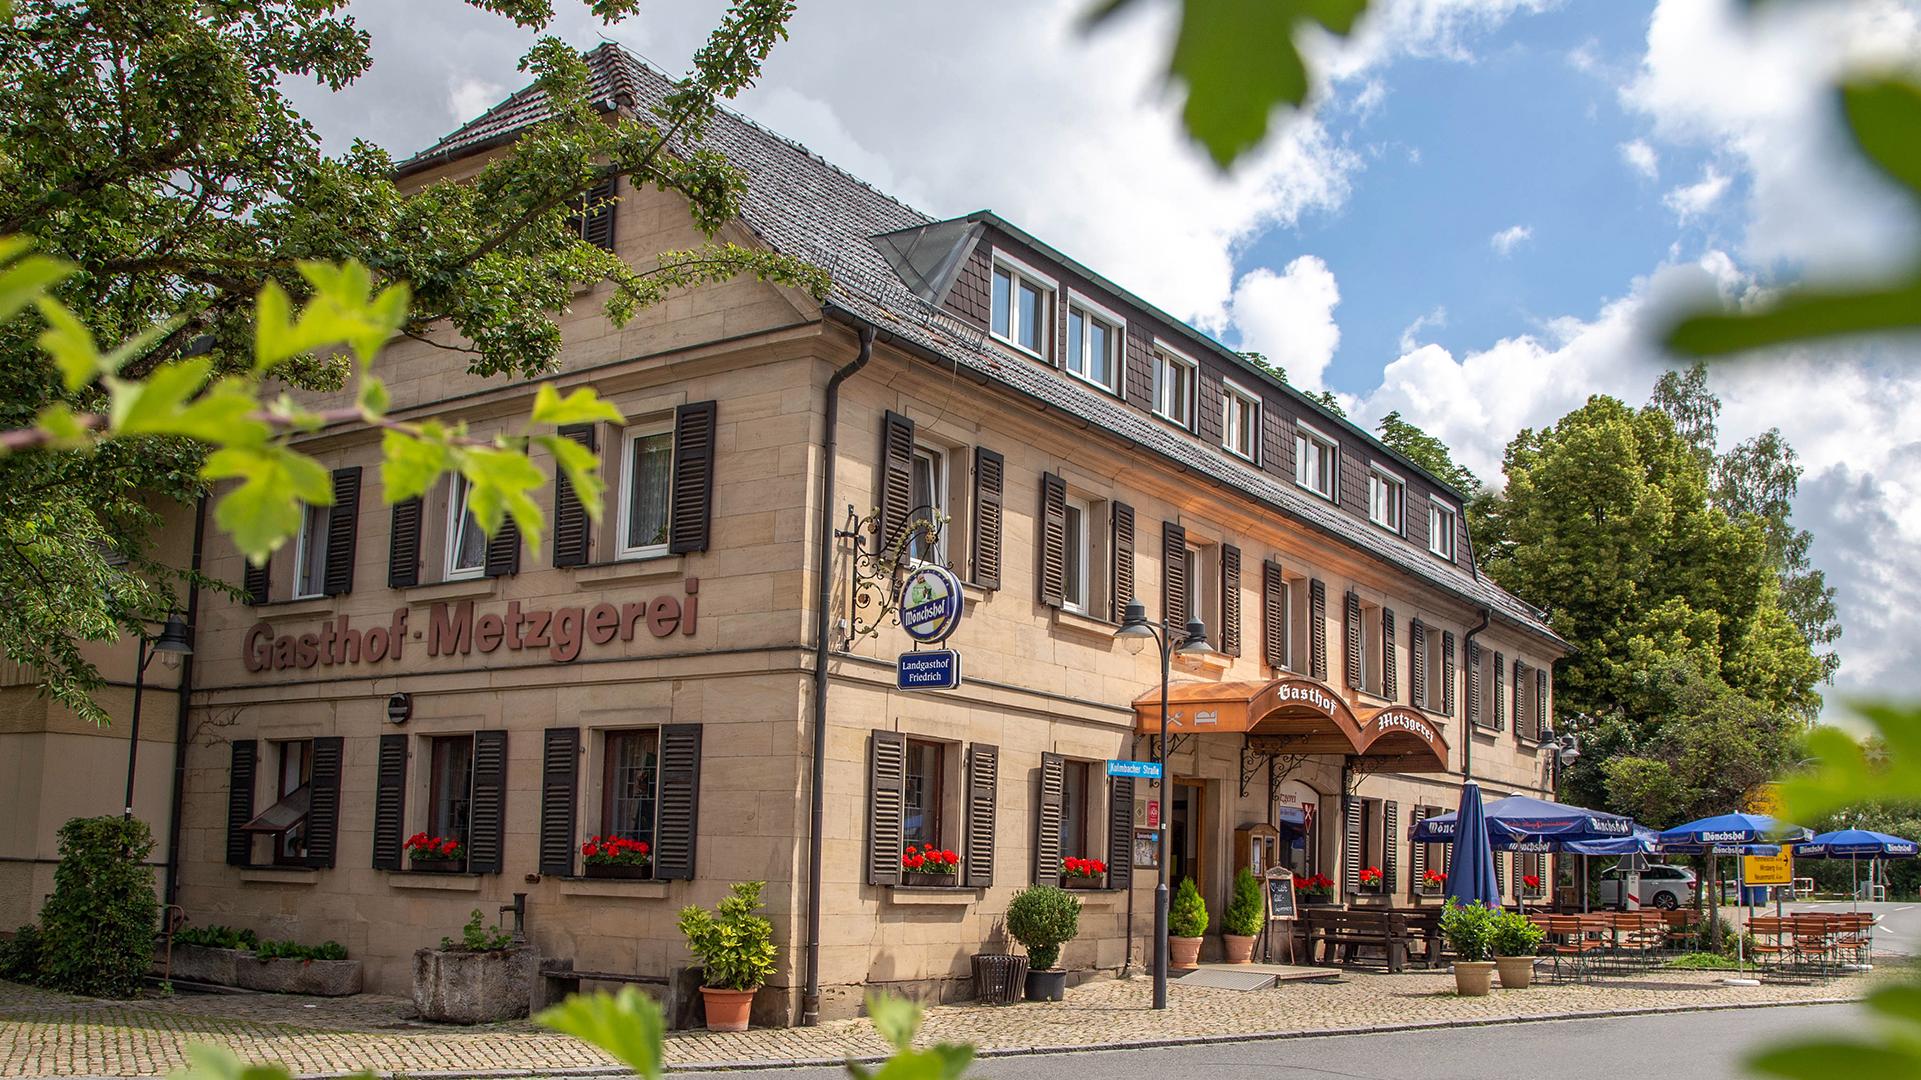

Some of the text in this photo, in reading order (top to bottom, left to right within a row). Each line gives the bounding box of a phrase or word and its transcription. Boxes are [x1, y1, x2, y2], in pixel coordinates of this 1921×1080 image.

[905, 599, 946, 626] Mönchshof
[242, 607, 408, 673] Gasthof
[427, 577, 699, 663] Metzgerei
[902, 658, 949, 671] Landgasthof
[909, 671, 942, 683] Friedrich
[1277, 683, 1337, 715] Gasthof
[1378, 712, 1434, 743] Metzgerei
[1429, 821, 1457, 834] Mönc
[1702, 830, 1745, 841] Mönchshof
